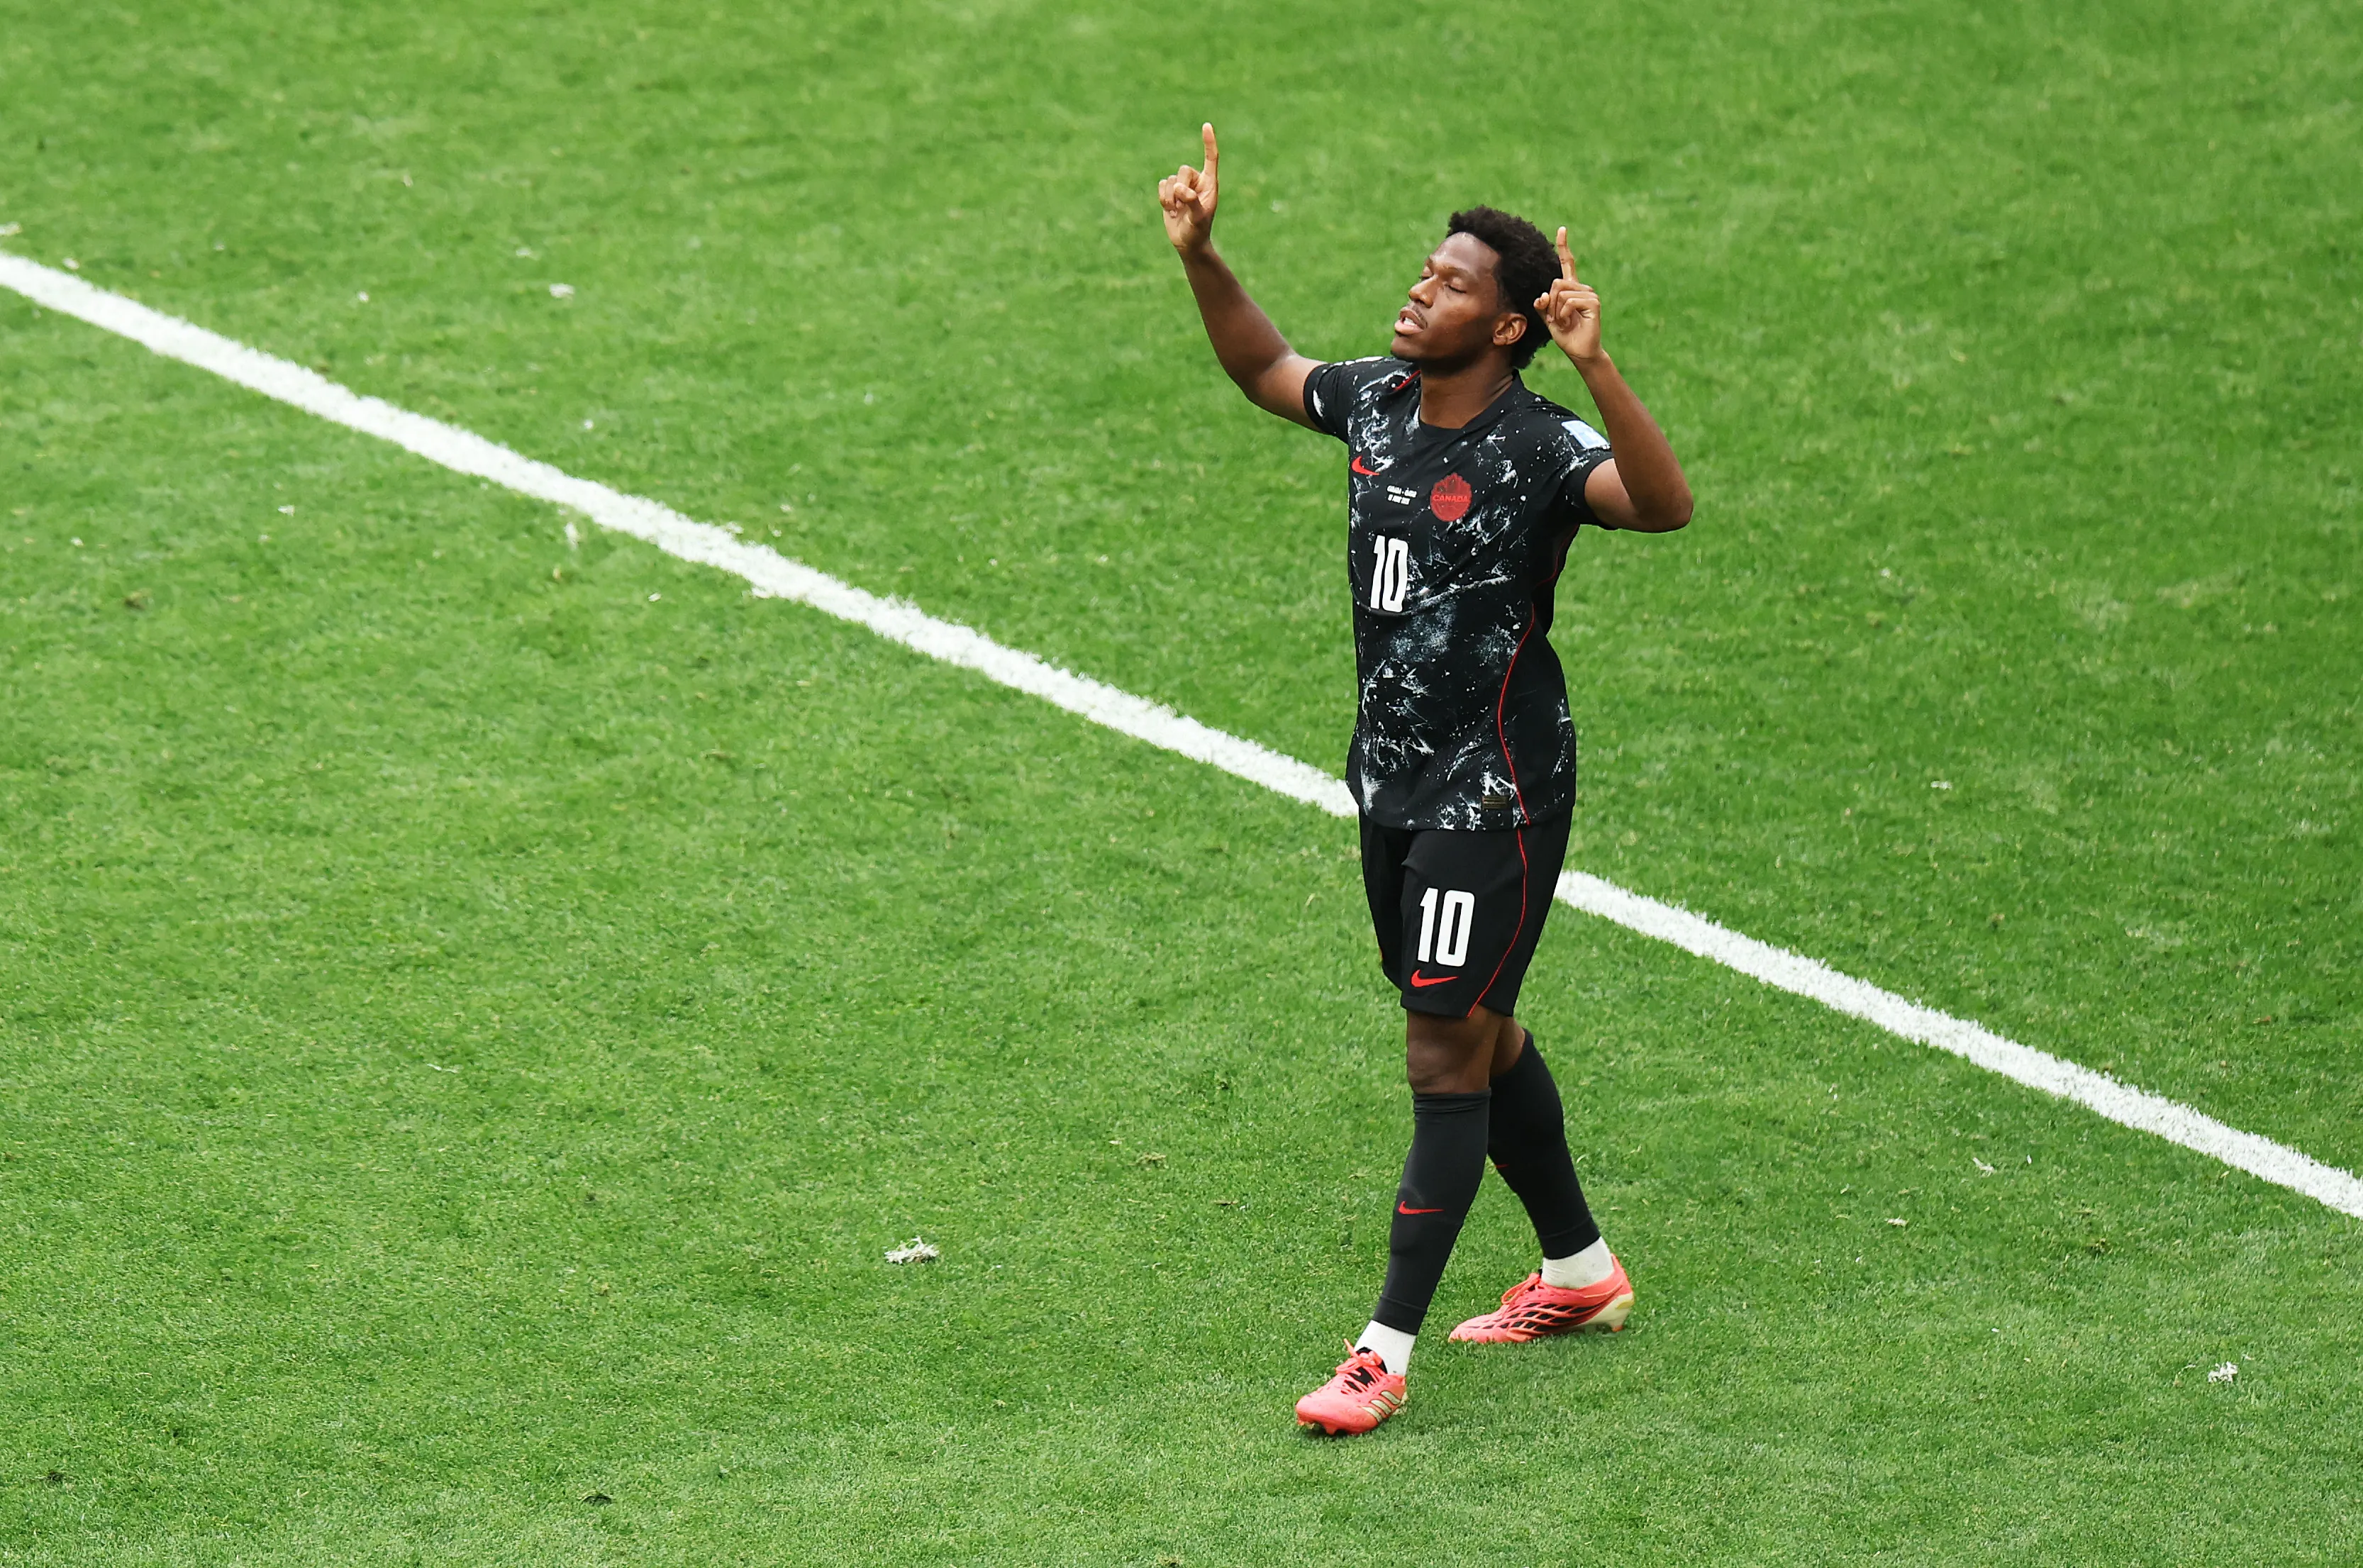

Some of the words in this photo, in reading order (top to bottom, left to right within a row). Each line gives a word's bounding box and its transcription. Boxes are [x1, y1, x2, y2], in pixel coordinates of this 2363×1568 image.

[1433, 494, 1468, 503] CANADA
[1370, 535, 1408, 613] 10
[1418, 887, 1475, 967] 10
